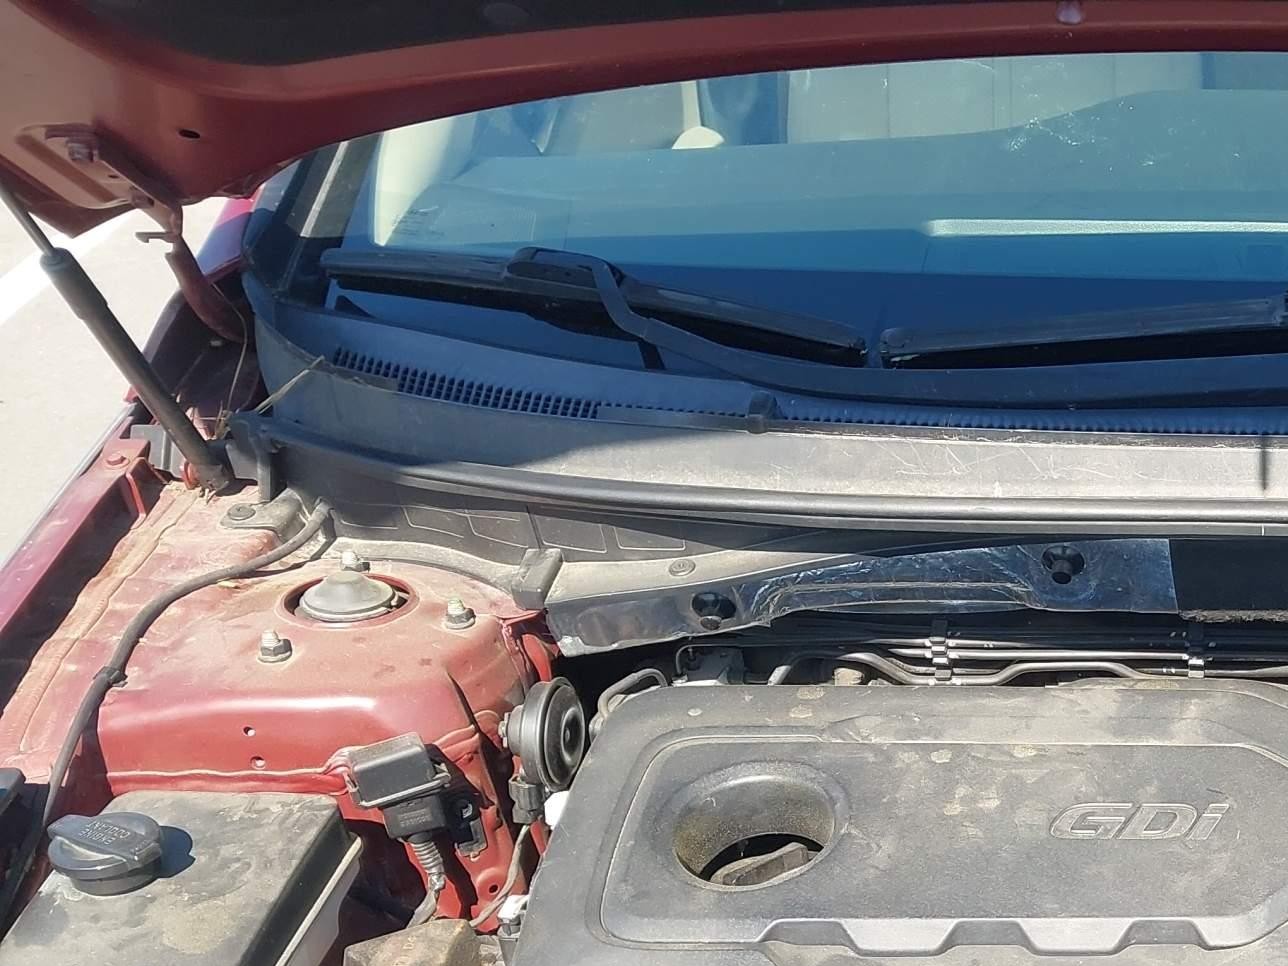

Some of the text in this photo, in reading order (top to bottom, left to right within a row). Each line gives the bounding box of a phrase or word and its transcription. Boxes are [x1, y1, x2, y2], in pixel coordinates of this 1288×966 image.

[84, 820, 131, 839] COOLANT
[1050, 801, 1230, 840] GDi
[78, 827, 117, 845] ENGINE
